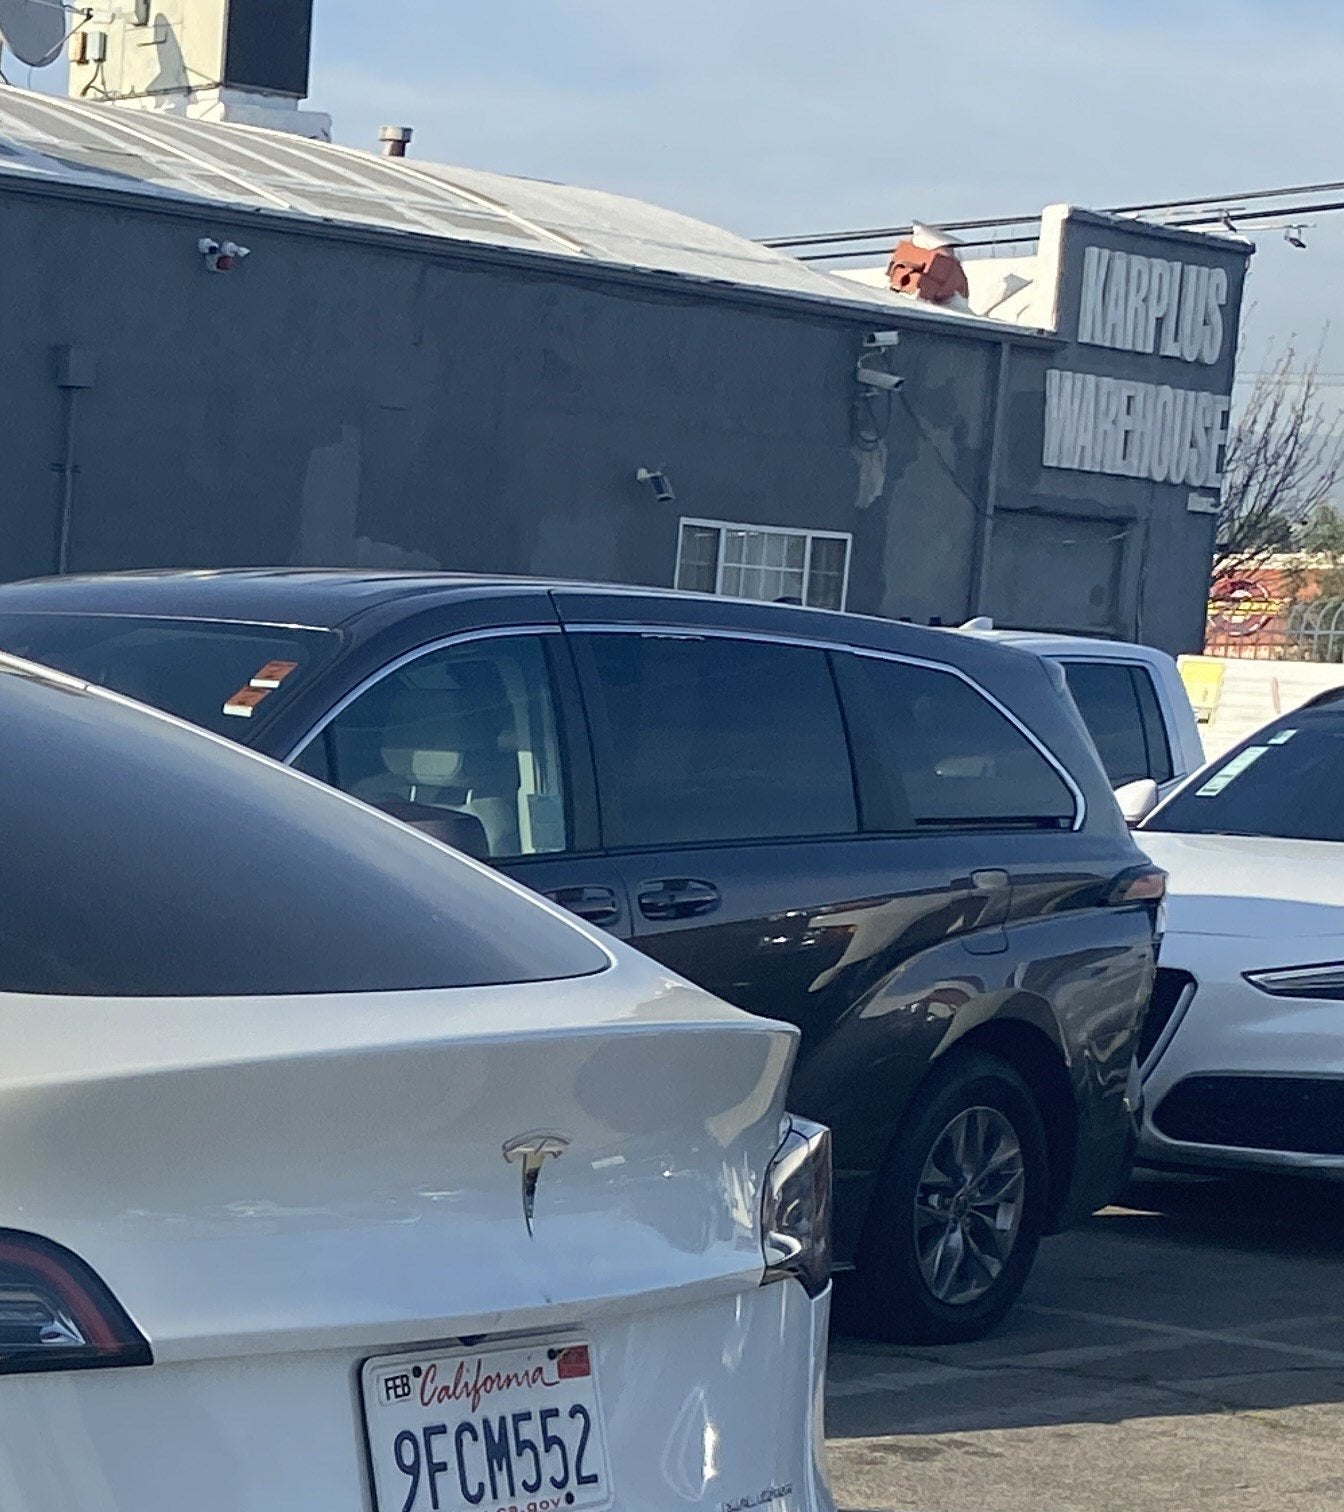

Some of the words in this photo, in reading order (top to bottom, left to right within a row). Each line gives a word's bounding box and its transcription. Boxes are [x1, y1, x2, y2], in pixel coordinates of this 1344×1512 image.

[1077, 246, 1228, 365] KARPLUS
[1042, 368, 1230, 489] WAREHOUSE
[383, 1374, 411, 1401] FEB
[419, 1358, 560, 1413] California
